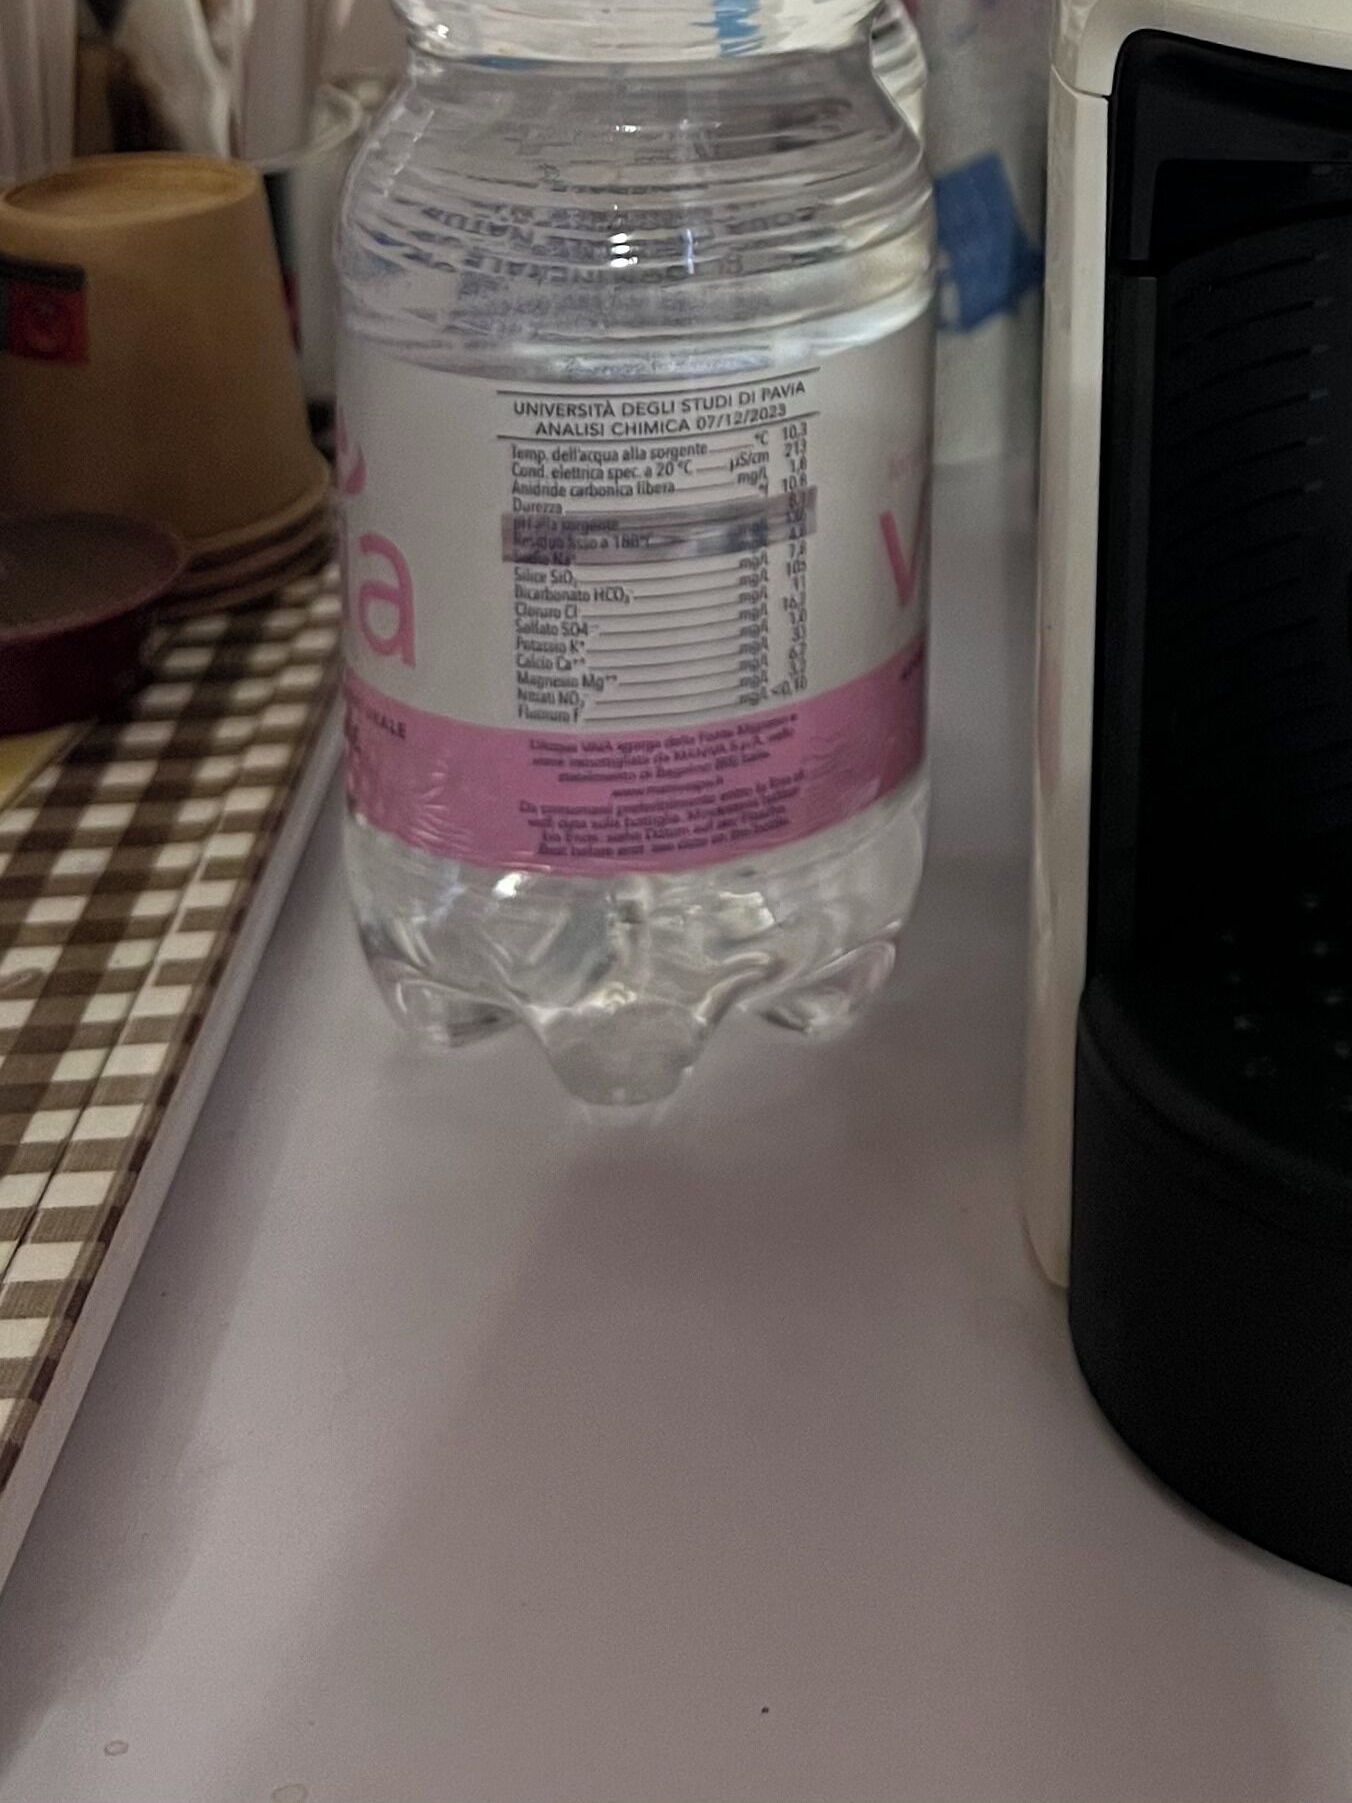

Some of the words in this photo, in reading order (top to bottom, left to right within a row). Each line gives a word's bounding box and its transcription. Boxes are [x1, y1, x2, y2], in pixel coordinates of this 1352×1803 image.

[513, 399, 616, 419] UNIVERSITÀ
[621, 400, 675, 417] DEGLI
[682, 395, 733, 414] STUDI
[739, 391, 756, 406] DI
[761, 381, 807, 403] PAVIA
[535, 421, 605, 437] ANALISI
[611, 421, 691, 437] CHIMICA
[696, 404, 787, 431] 07/12/2023
[511, 444, 549, 465] Temp.
[552, 445, 619, 465] dell'acqua
[623, 445, 647, 462] alla
[650, 442, 708, 464] sorgente
[551, 463, 605, 481] elettrica
[656, 462, 675, 477] 20
[570, 480, 633, 497] carbonica
[637, 479, 675, 495] libera
[512, 498, 563, 515] Durezza
